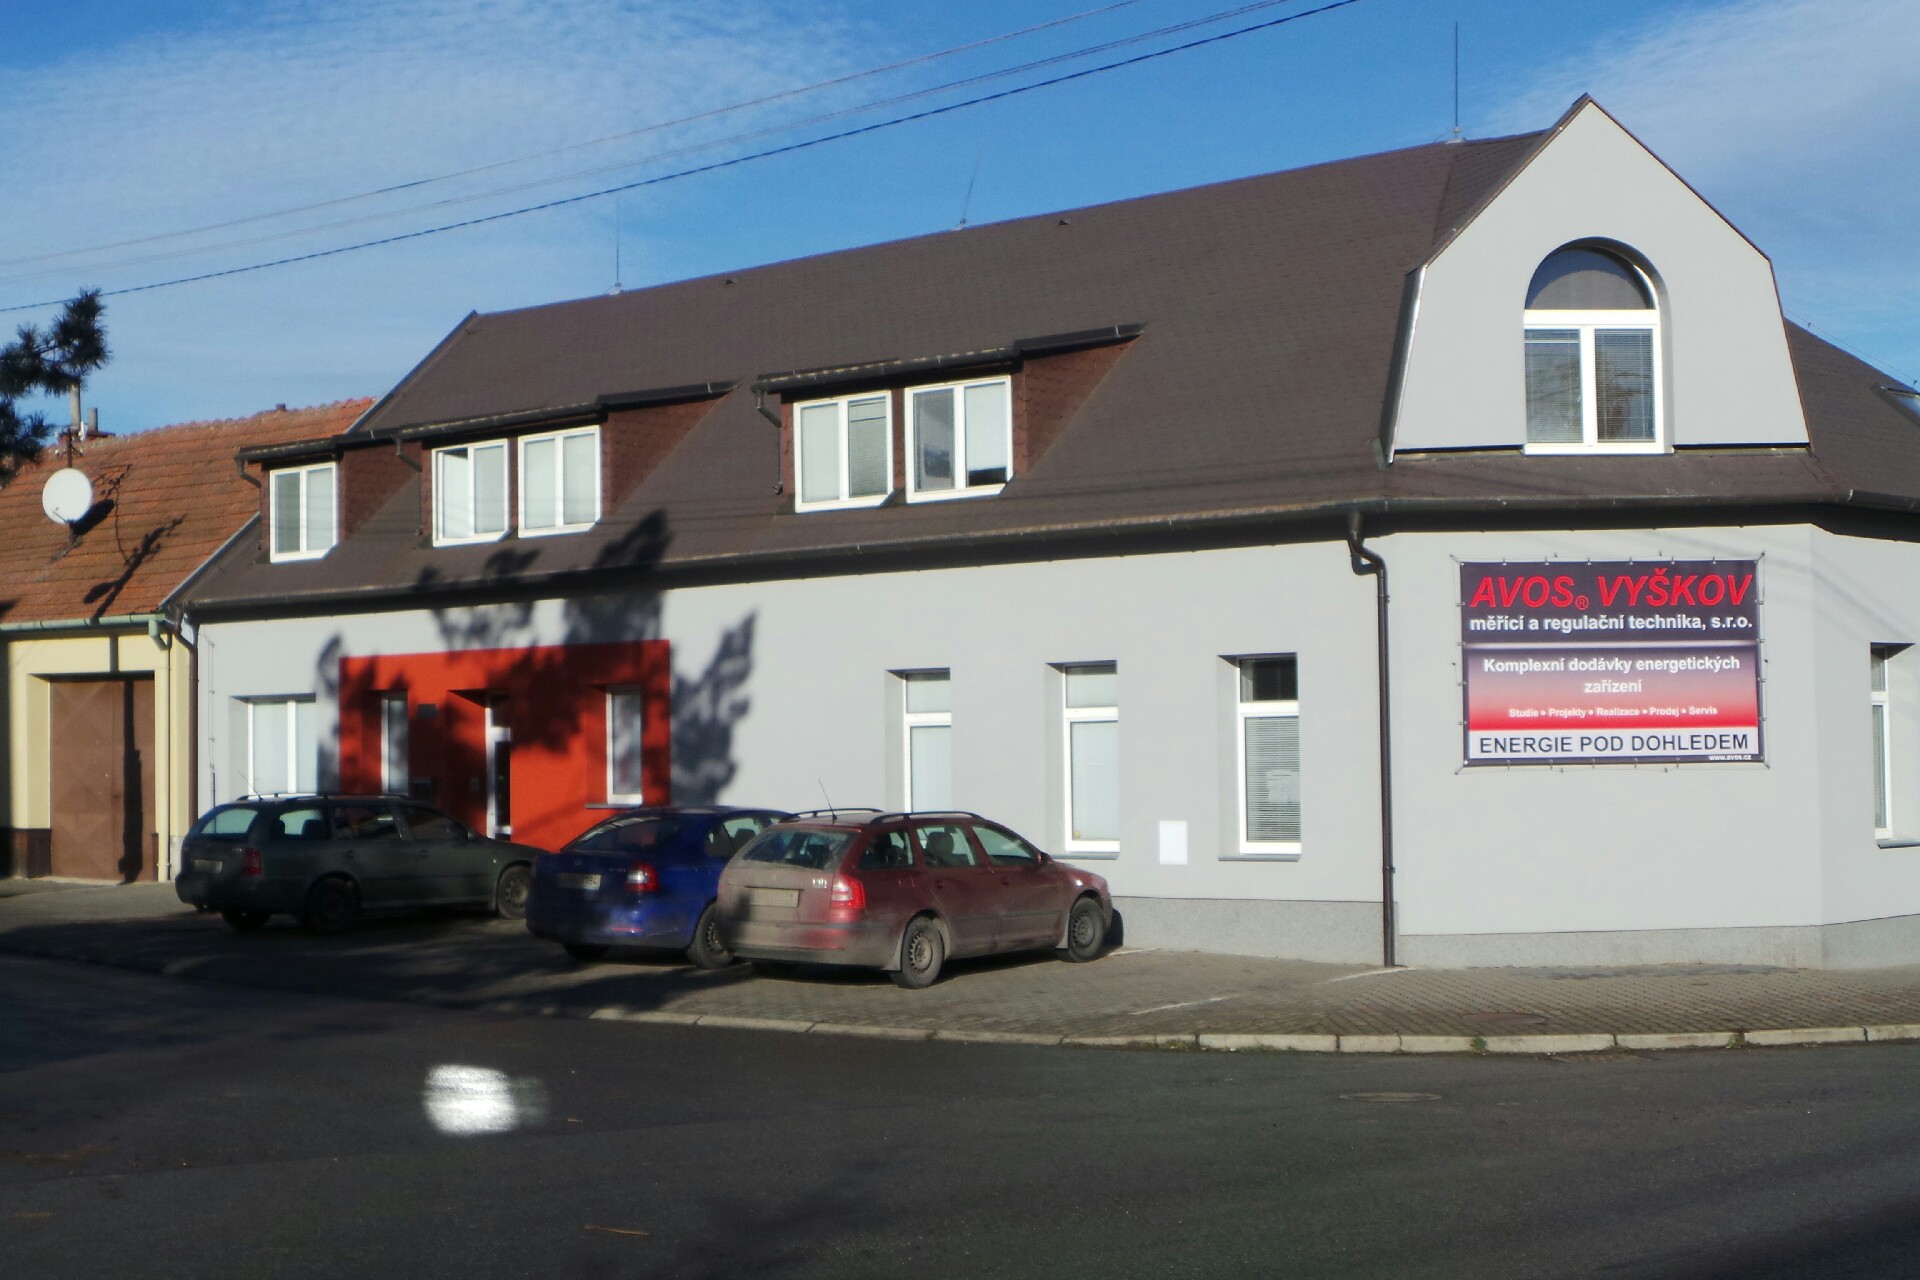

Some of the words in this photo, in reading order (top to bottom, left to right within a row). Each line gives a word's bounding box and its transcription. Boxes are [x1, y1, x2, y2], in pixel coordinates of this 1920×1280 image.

[1470, 576, 1574, 608] AVOS
[1598, 568, 1752, 607] VYŠKOV
[1529, 618, 1539, 629] a
[1544, 615, 1624, 633] regulační
[1629, 615, 1706, 630] technika,
[1711, 616, 1752, 628] s.r.o.
[1484, 658, 1564, 675] Komplexní
[1569, 658, 1632, 673] dodávky
[1636, 656, 1740, 672] energetických
[1584, 679, 1642, 694] zařízení
[1509, 709, 1539, 718] Studie
[1549, 708, 1586, 718] Projekty
[1596, 707, 1639, 716] Realizace
[1650, 706, 1680, 717] Prodej
[1689, 706, 1718, 715] Servis
[1480, 737, 1573, 753] ENERGIE
[1580, 736, 1624, 752] POD
[1631, 734, 1748, 751] DOHLEDEM
